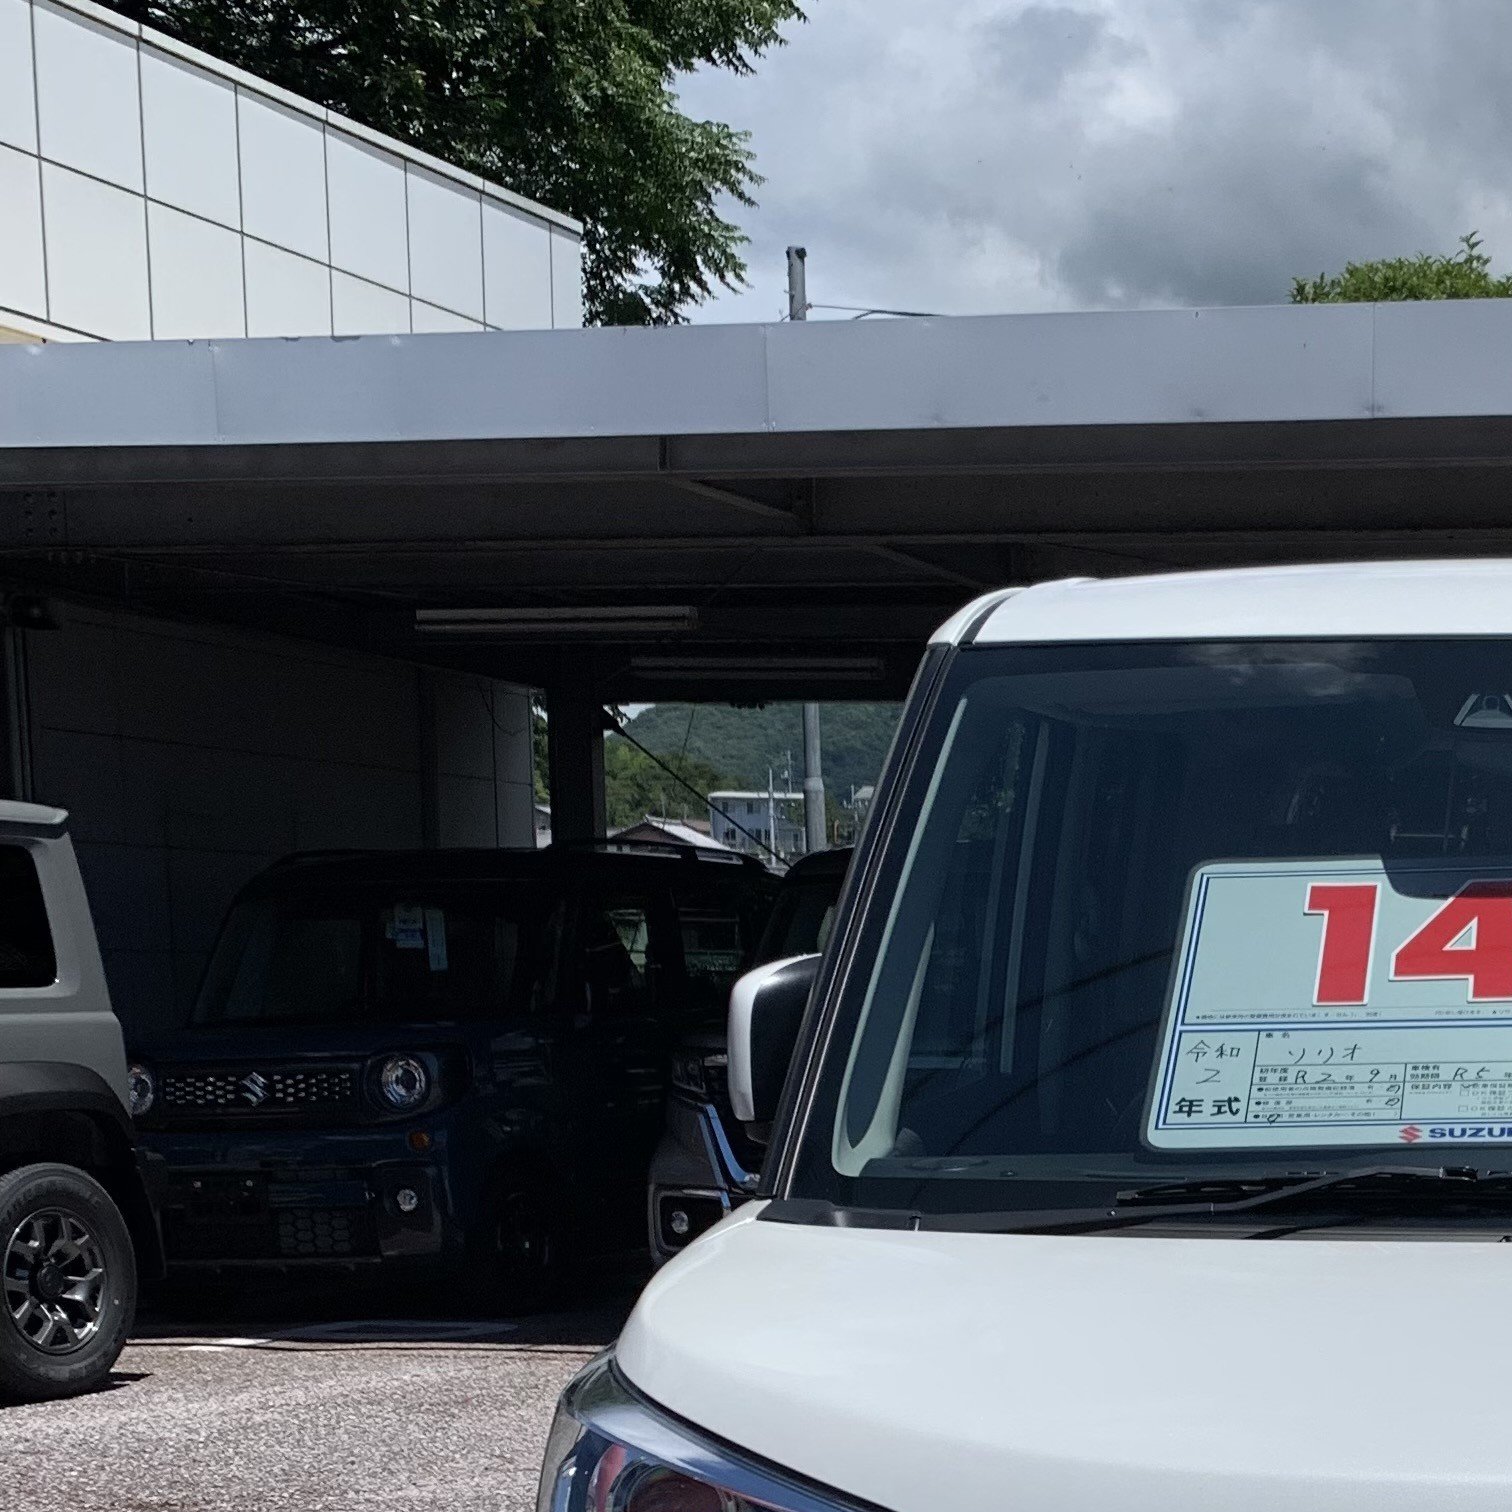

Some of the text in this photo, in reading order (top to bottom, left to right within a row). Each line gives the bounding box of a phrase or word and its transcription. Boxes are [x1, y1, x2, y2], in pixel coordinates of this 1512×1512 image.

[1185, 1039, 1242, 1064] 令和
[1288, 1043, 1362, 1065] ソリオ
[1172, 1096, 1242, 1118] 年式
